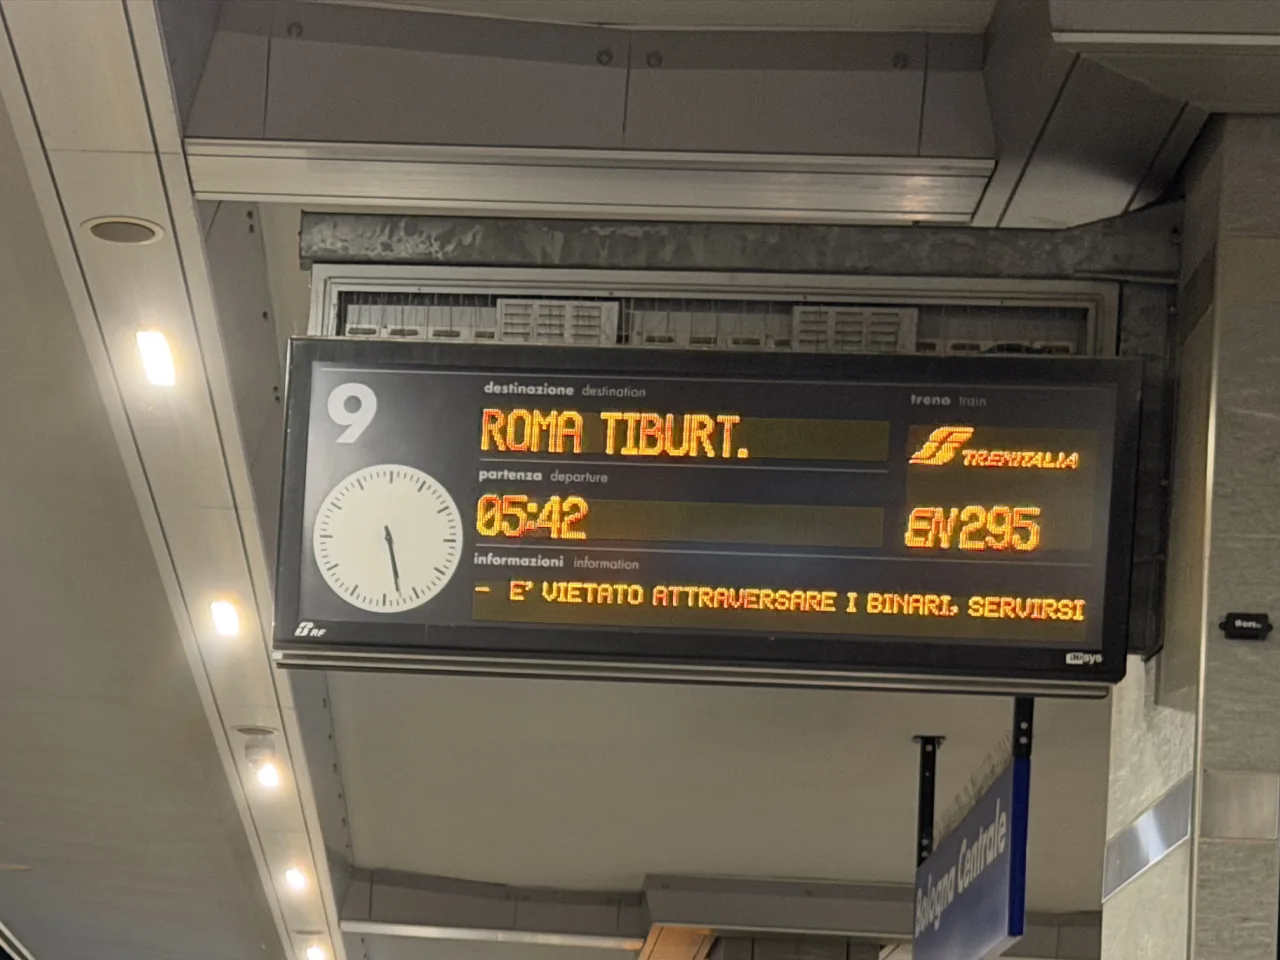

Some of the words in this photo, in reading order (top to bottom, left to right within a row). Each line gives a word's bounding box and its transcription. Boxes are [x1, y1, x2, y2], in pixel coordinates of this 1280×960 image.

[484, 381, 574, 396] destinazione
[582, 384, 646, 397] destination
[911, 395, 951, 406] treno
[327, 382, 377, 443] 9
[481, 409, 583, 454] ROMA
[600, 412, 749, 459] TIBURT.
[962, 449, 1079, 469] TRENITALIA
[479, 468, 543, 482] partenza
[550, 470, 608, 484] departure
[476, 494, 588, 540] 05:42
[474, 553, 564, 568] informazioni
[573, 556, 639, 570] information
[542, 581, 644, 605] VIETATO
[652, 584, 837, 613] ATTRAVERSARE
[846, 592, 858, 613] I
[867, 593, 959, 617] BINARI,
[968, 596, 1086, 621] SERVIRSI
[915, 865, 955, 939] Bologna
[957, 797, 1007, 894] Centrale
